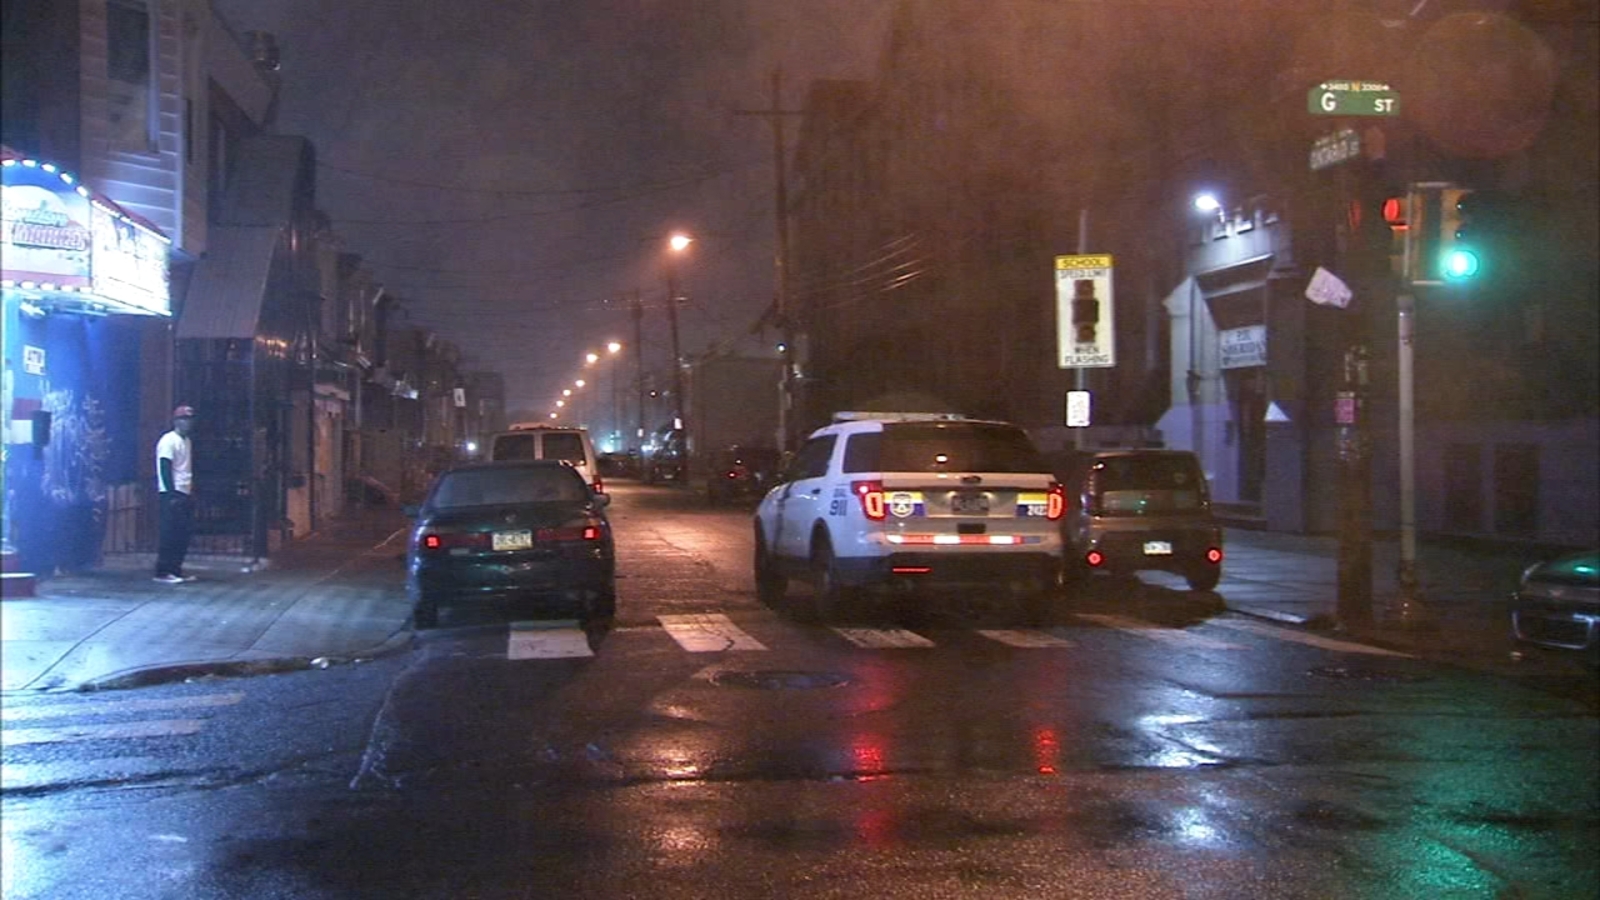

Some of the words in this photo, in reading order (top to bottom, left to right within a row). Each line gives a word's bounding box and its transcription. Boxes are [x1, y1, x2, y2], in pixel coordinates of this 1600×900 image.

[1321, 92, 1336, 112] G
[1374, 98, 1394, 112] ST
[1063, 258, 1107, 268] SCHOOL
[1060, 269, 1084, 279] SPEED
[1074, 346, 1099, 355] WHEN
[1064, 354, 1108, 365] FLASHING
